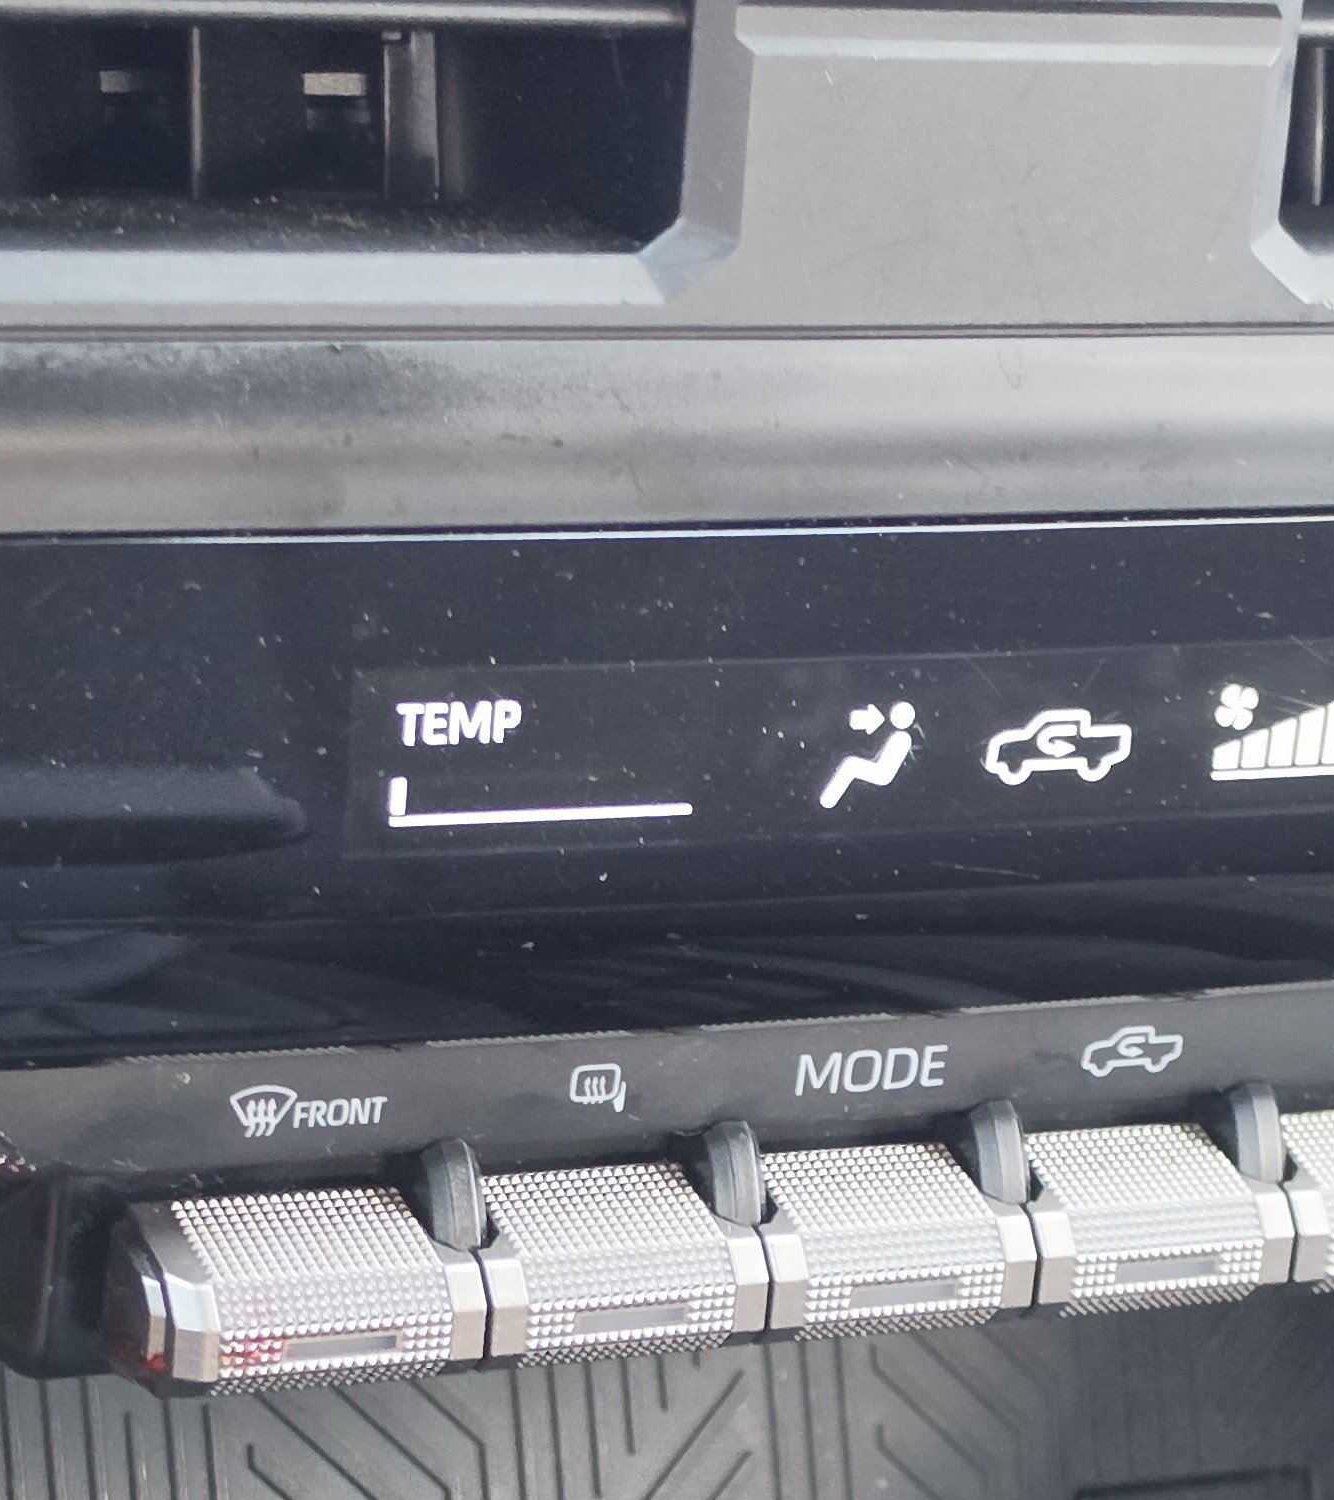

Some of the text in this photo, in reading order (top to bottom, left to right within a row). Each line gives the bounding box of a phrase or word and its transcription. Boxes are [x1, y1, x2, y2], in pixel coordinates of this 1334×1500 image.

[395, 700, 521, 746] TEMP
[794, 1044, 949, 1096] MODE
[293, 1096, 387, 1128] FRONT
